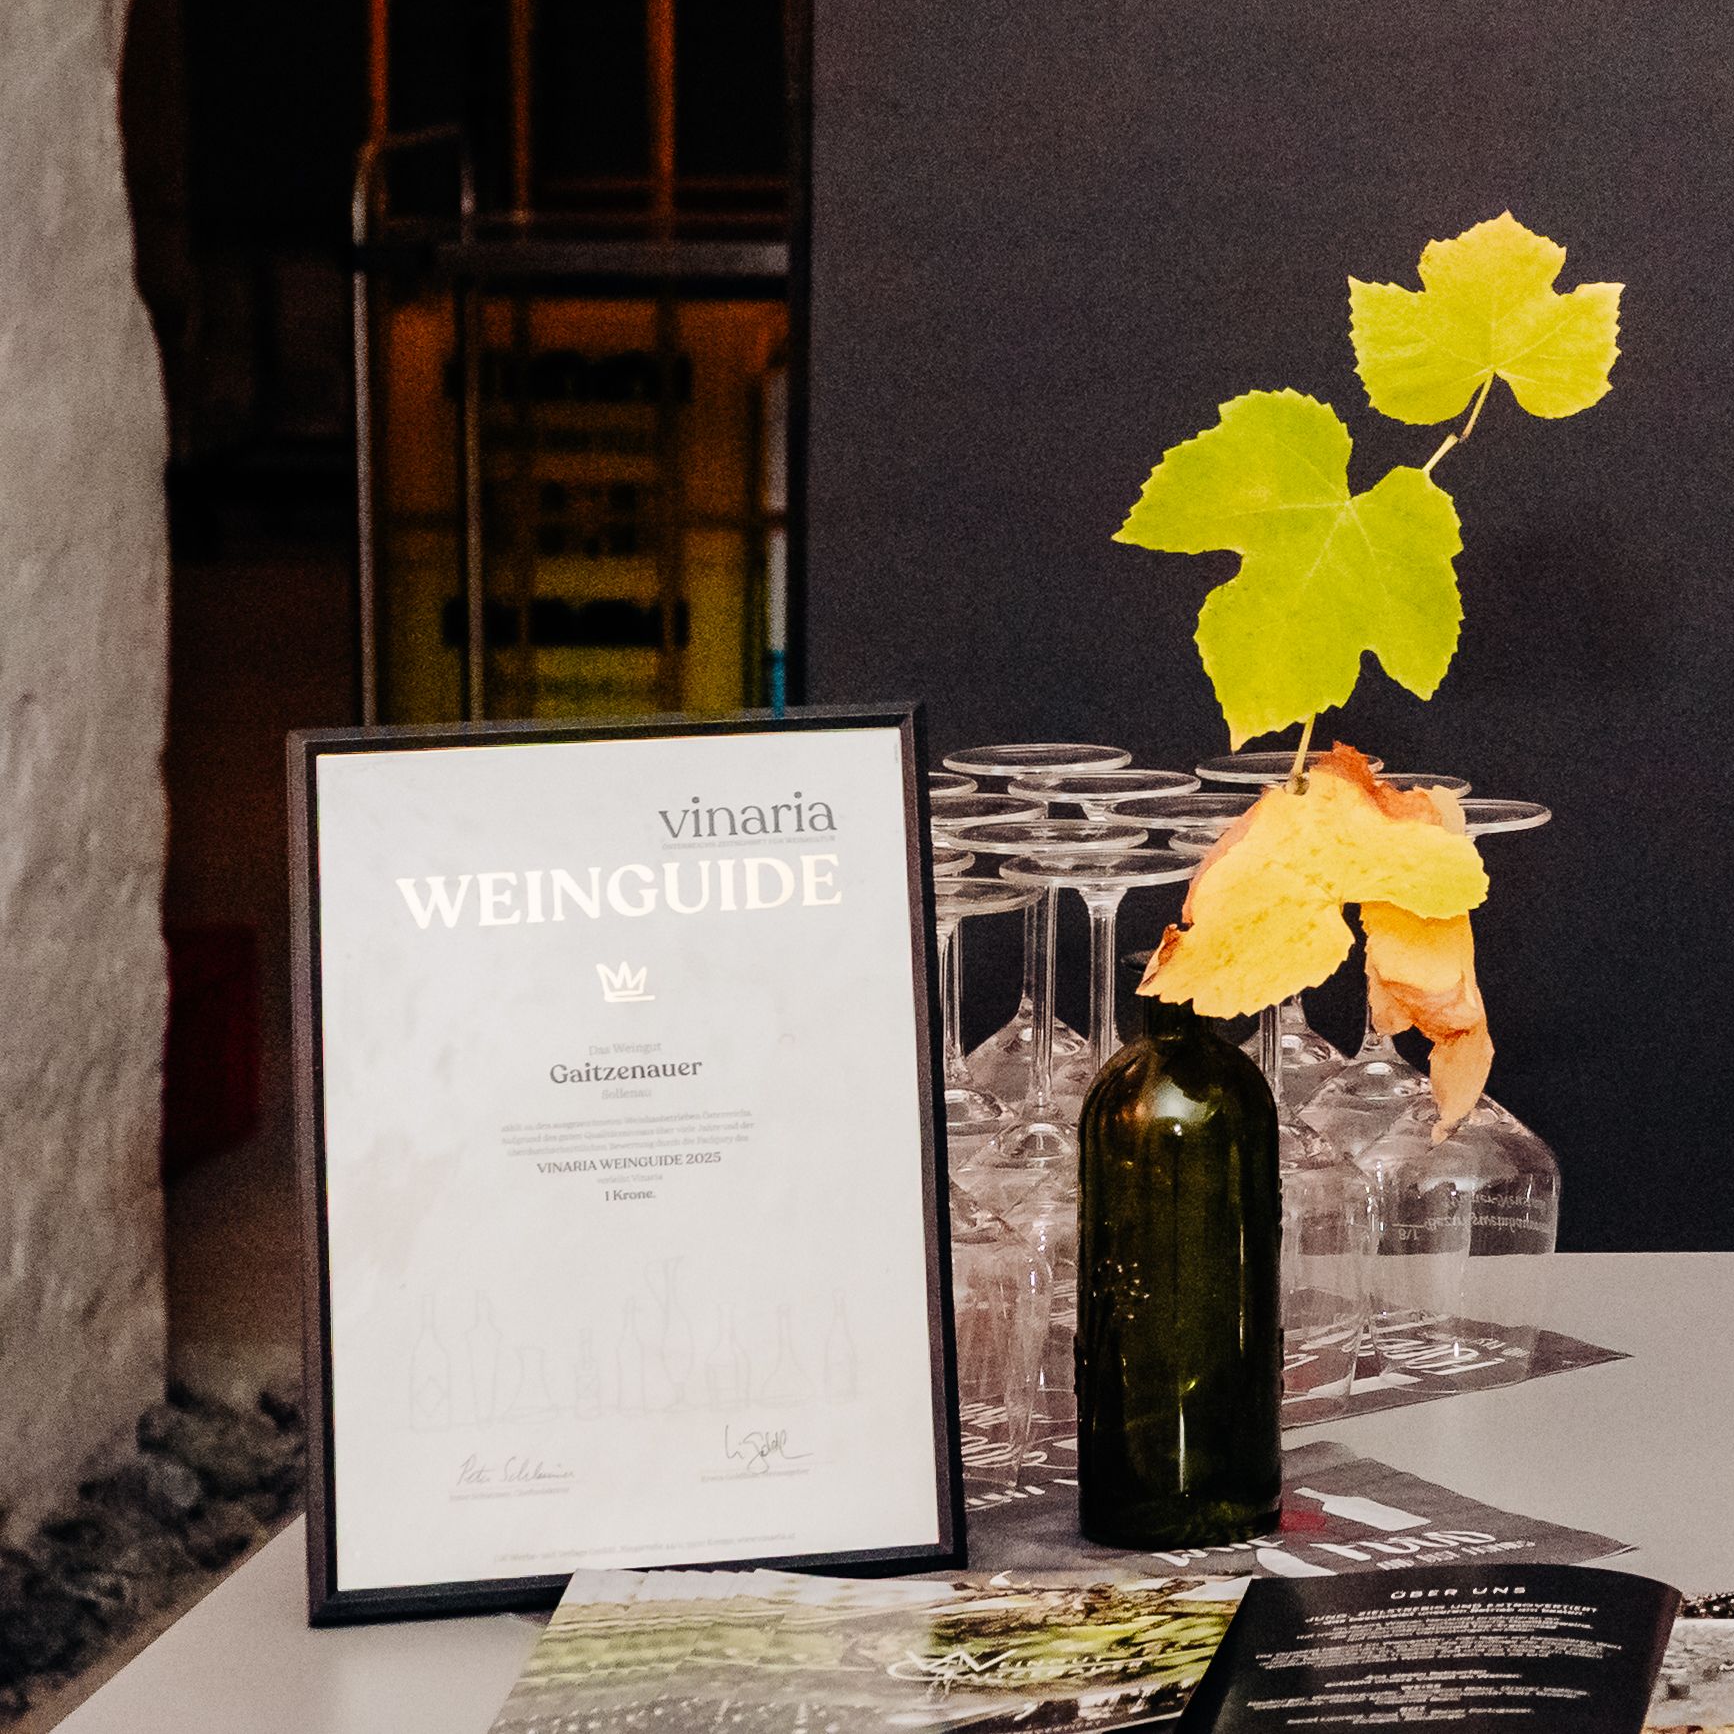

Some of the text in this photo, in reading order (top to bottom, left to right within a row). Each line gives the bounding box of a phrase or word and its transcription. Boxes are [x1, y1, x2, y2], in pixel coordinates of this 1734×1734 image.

[658, 791, 837, 838] vinaria
[396, 854, 842, 931] WEINGUIDE
[613, 1041, 662, 1057] Weingut
[550, 1059, 703, 1085] Gaitzenauer
[536, 1151, 722, 1174] VINARIA WEINGUIDE 2025
[612, 1188, 656, 1202] Krone.
